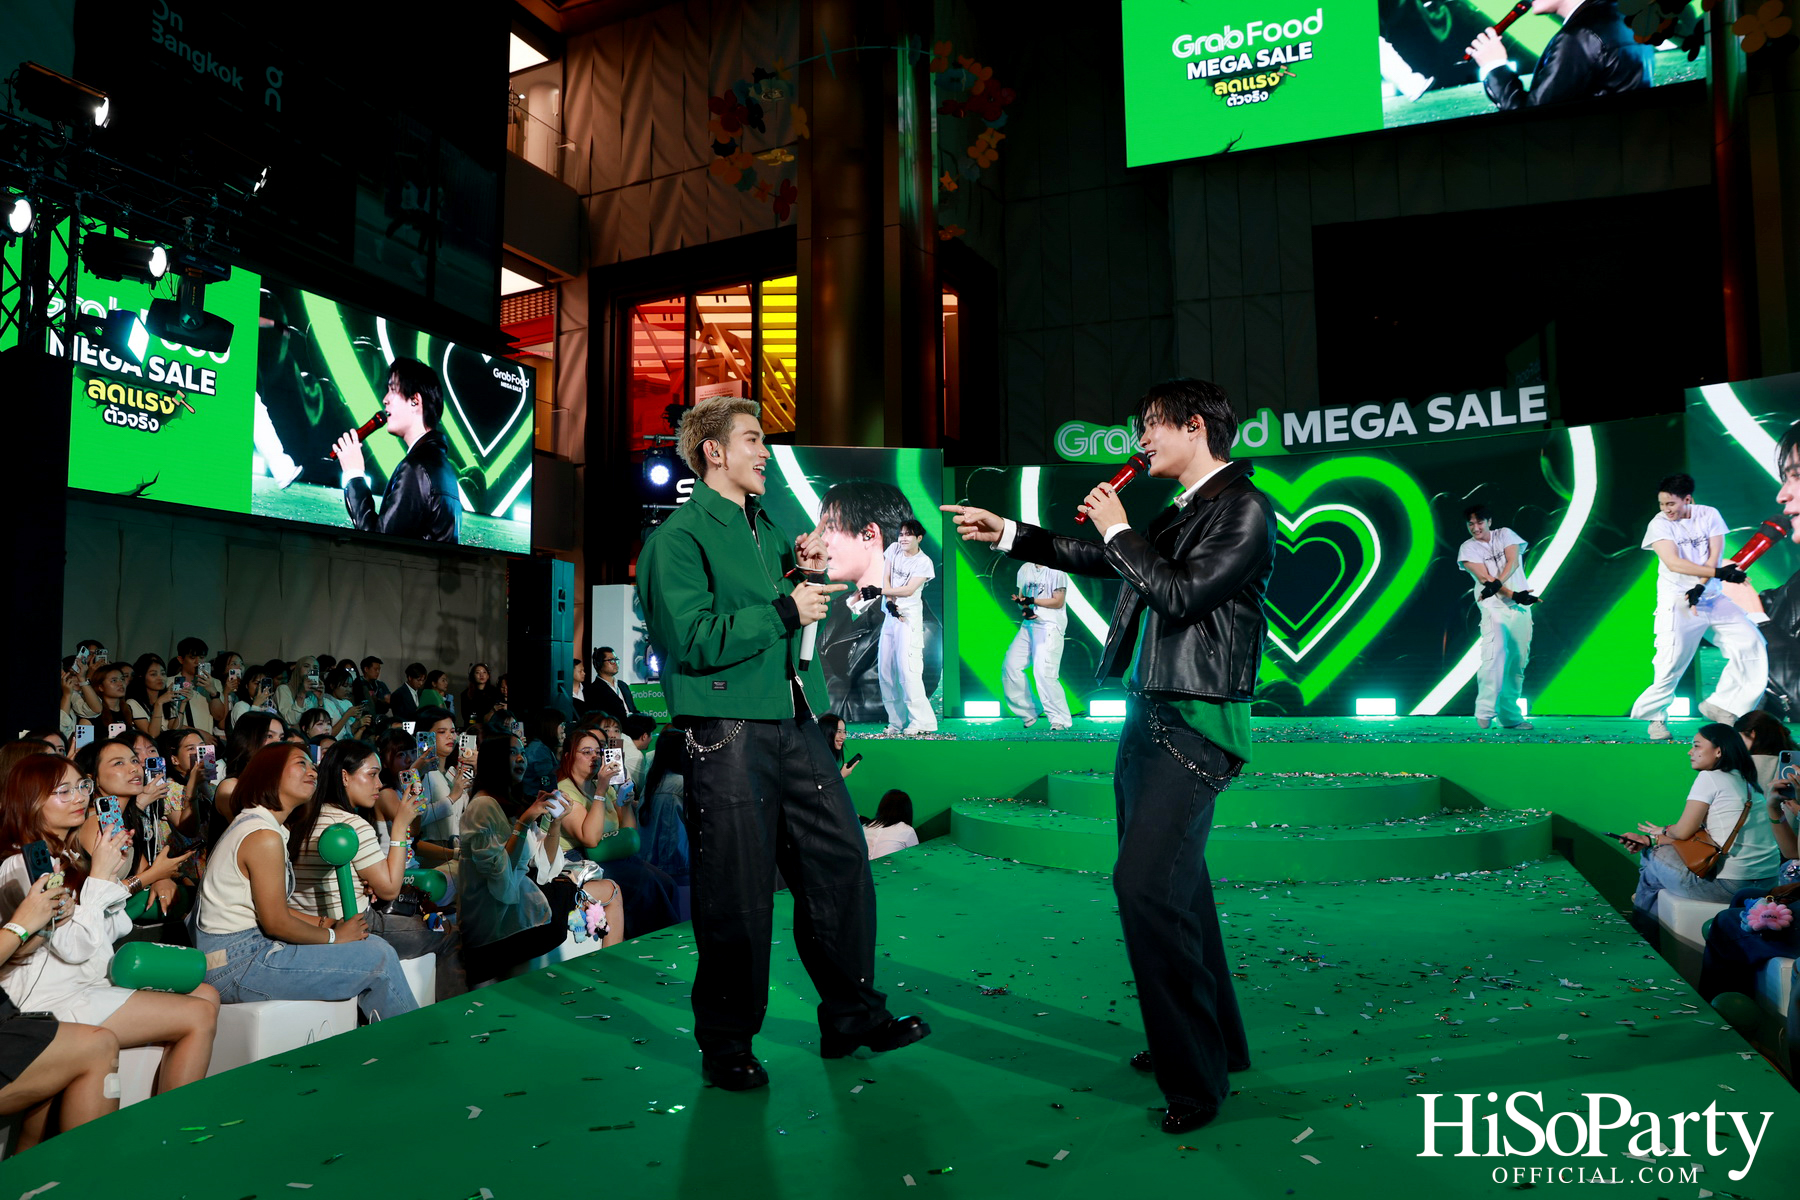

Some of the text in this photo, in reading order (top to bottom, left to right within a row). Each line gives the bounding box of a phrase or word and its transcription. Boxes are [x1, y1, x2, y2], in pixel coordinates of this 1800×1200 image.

[1187, 41, 1313, 80] MEGA SALE
[1214, 73, 1280, 95] ลดแรง
[1226, 90, 1269, 107] ตัวจริง
[148, 355, 216, 395] SALE
[87, 379, 176, 415] ลดแรง
[103, 405, 160, 432] ตัวจริง
[1283, 401, 1418, 446] MEGA
[1427, 385, 1547, 433] SALE
